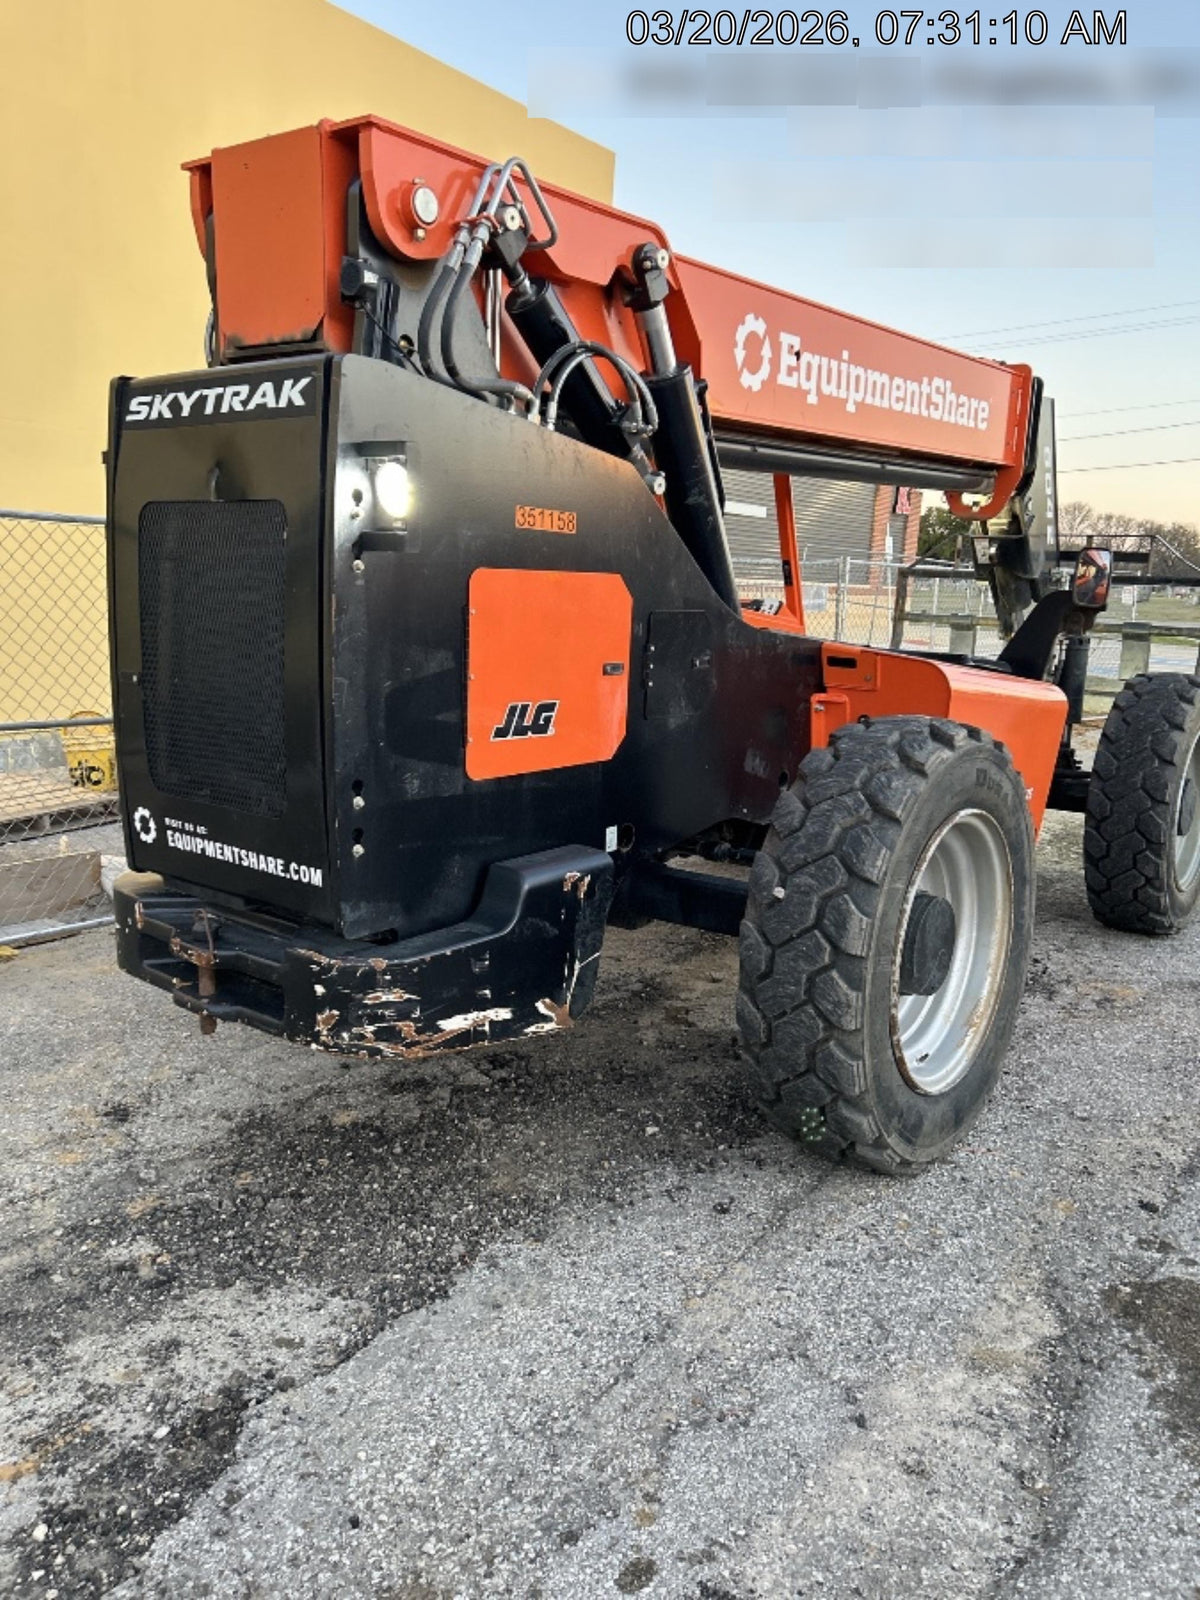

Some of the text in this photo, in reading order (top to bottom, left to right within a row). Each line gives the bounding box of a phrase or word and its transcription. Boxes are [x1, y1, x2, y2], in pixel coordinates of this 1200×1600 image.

[125, 376, 313, 422] SKYTRAK
[777, 332, 990, 430] EquipmentShare
[516, 505, 575, 532] 351158
[490, 699, 560, 741] JLG
[166, 829, 323, 888] EQUIPMENTSHARE.COM
